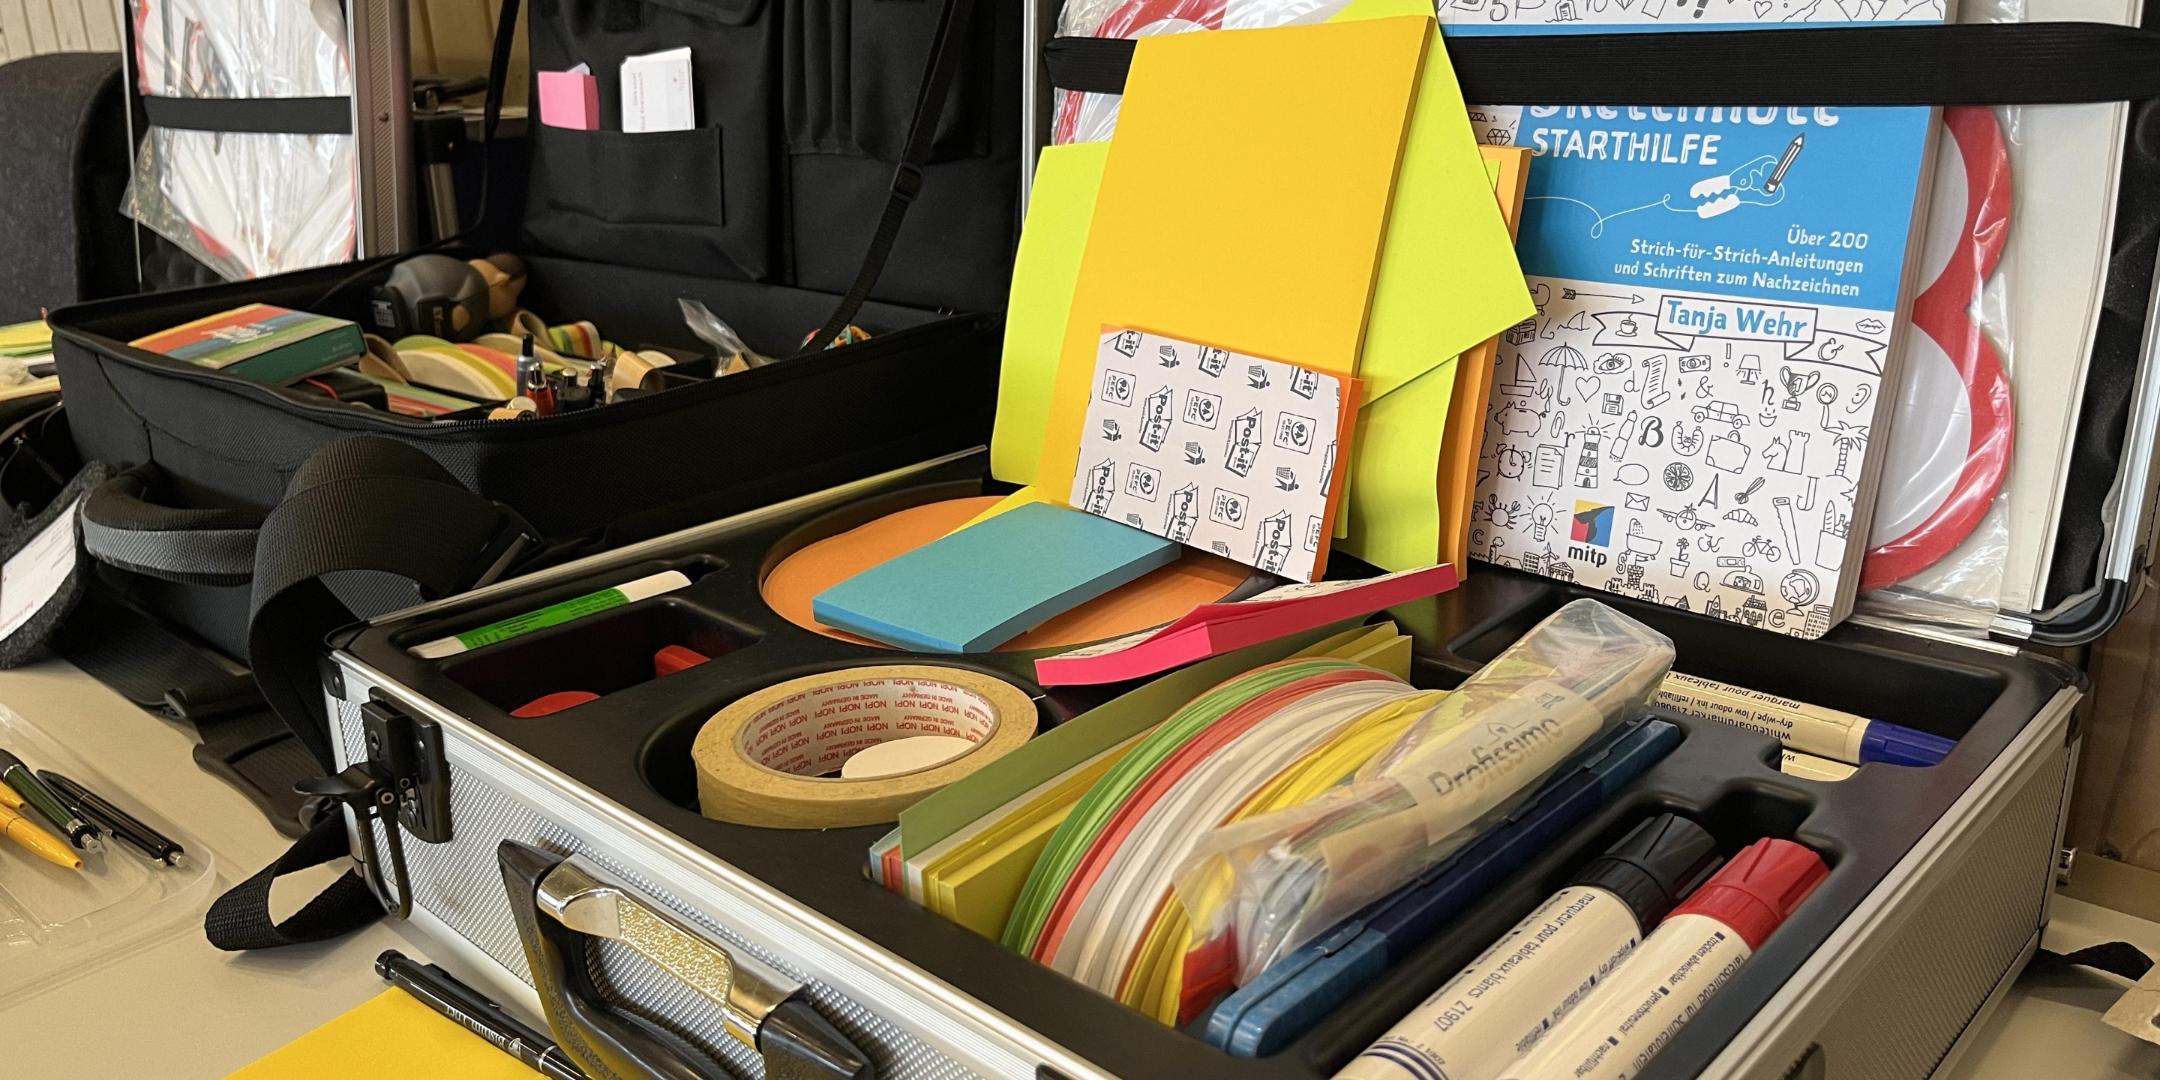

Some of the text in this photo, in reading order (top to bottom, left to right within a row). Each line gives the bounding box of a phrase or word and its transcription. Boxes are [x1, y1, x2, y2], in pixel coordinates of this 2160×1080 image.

[1531, 127, 1722, 166] STARTHILFE
[1787, 223, 1868, 250] Über 200
[1630, 238, 1864, 276] Strich-für-Strich-Anleitungen
[1614, 261, 1860, 297] und Schriften zum Nachzeichnen
[1667, 300, 1808, 338] Tanja Wehr
[1696, 376, 1714, 399] &
[1150, 394, 1168, 447] Post-it
[1638, 415, 1664, 448] B
[1235, 415, 1256, 471] Post-it
[1092, 465, 1110, 515] Post-it
[1698, 473, 1719, 510] A
[1174, 490, 1193, 542] Post-it
[1265, 517, 1286, 574] Post-it
[1567, 545, 1608, 568] mitp
[1673, 673, 1720, 691] tableaux
[1721, 685, 1749, 698] pour
[814, 701, 887, 718] NOPI NOPI NOPI
[1695, 700, 1709, 710] ink
[1709, 702, 1734, 714] odour
[1734, 707, 1750, 719] low
[1756, 714, 1793, 729] dry-wipe
[816, 722, 888, 741] NOPI NOPI NOPI
[1557, 892, 1597, 927] marqueur
[1533, 920, 1559, 946] pour
[1500, 940, 1541, 976] tableaux
[1468, 968, 1505, 999] blancs
[1433, 999, 1474, 1032] Z1907
